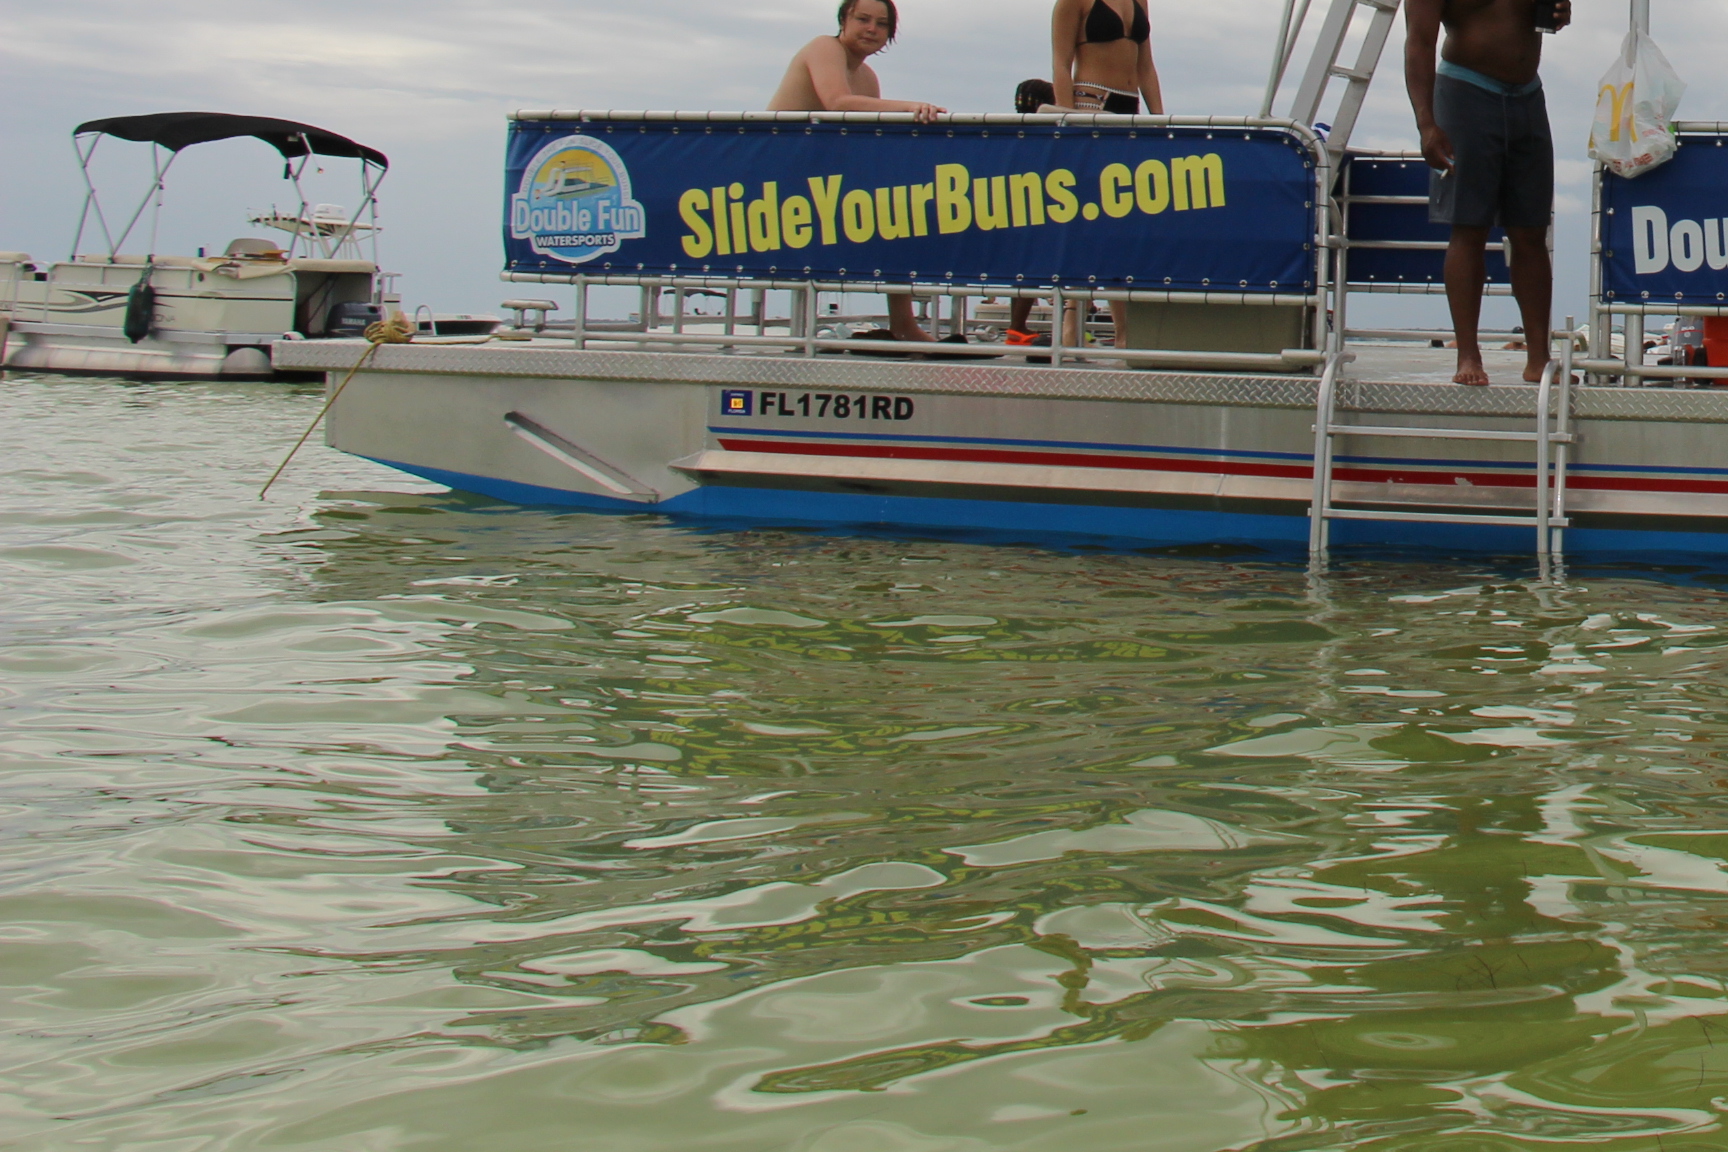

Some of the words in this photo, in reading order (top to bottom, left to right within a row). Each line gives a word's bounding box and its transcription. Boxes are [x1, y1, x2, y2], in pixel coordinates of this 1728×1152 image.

[516, 200, 592, 232] Double
[597, 200, 640, 231] Fun
[679, 154, 1225, 258] SlideYourBuns.com
[536, 234, 615, 247] WATERSPORTS
[760, 392, 915, 421] FL1781RD
